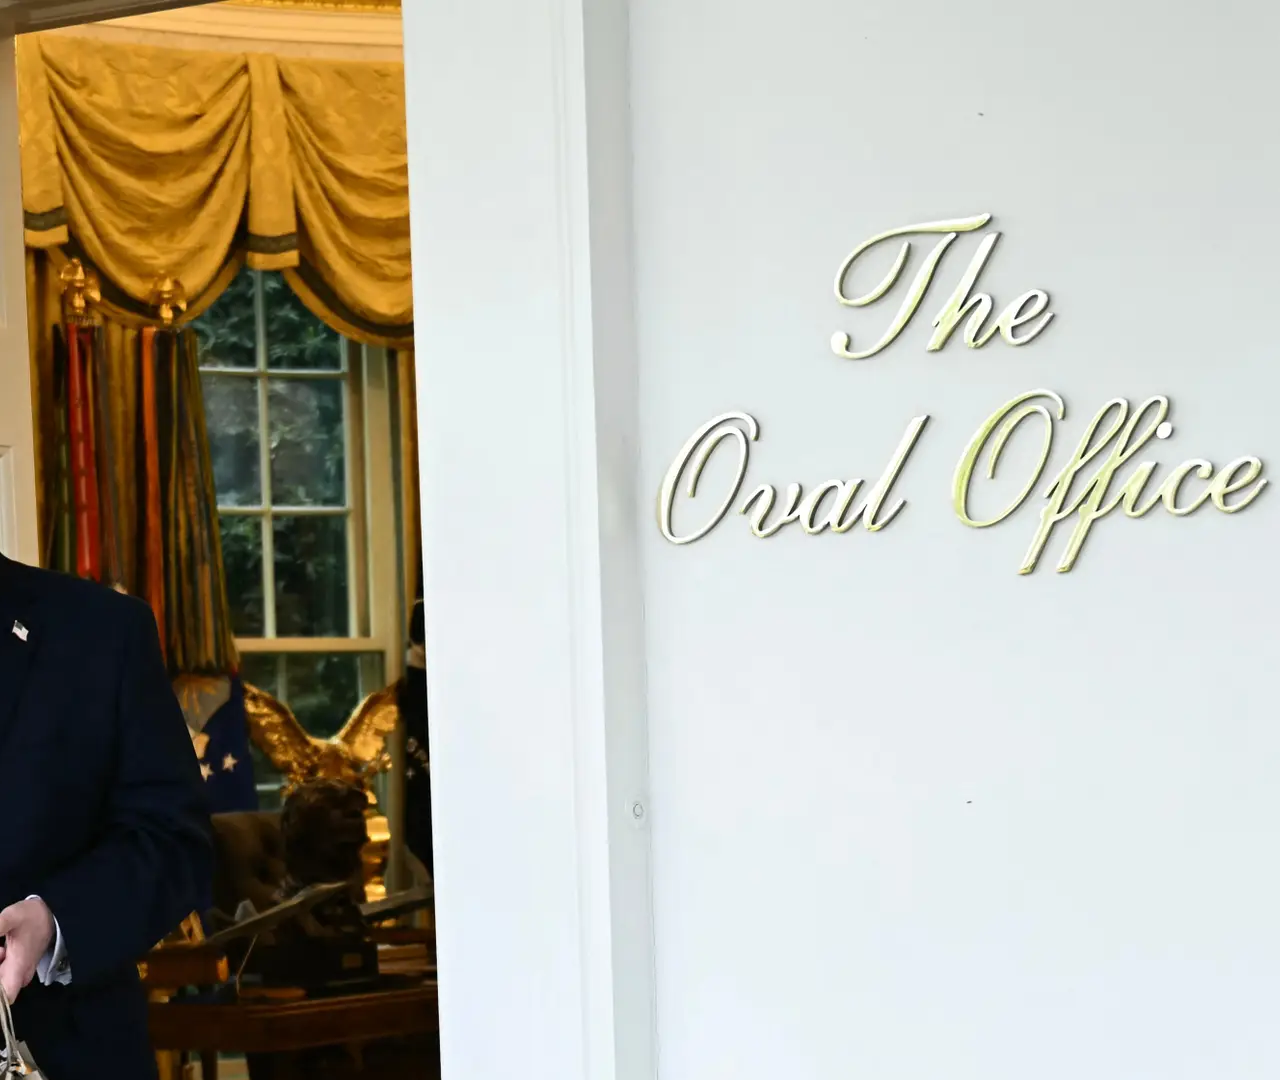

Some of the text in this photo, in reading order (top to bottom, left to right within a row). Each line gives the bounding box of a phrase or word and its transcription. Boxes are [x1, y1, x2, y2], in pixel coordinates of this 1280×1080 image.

[830, 213, 1055, 359] The
[657, 388, 1269, 576] Oval Office
